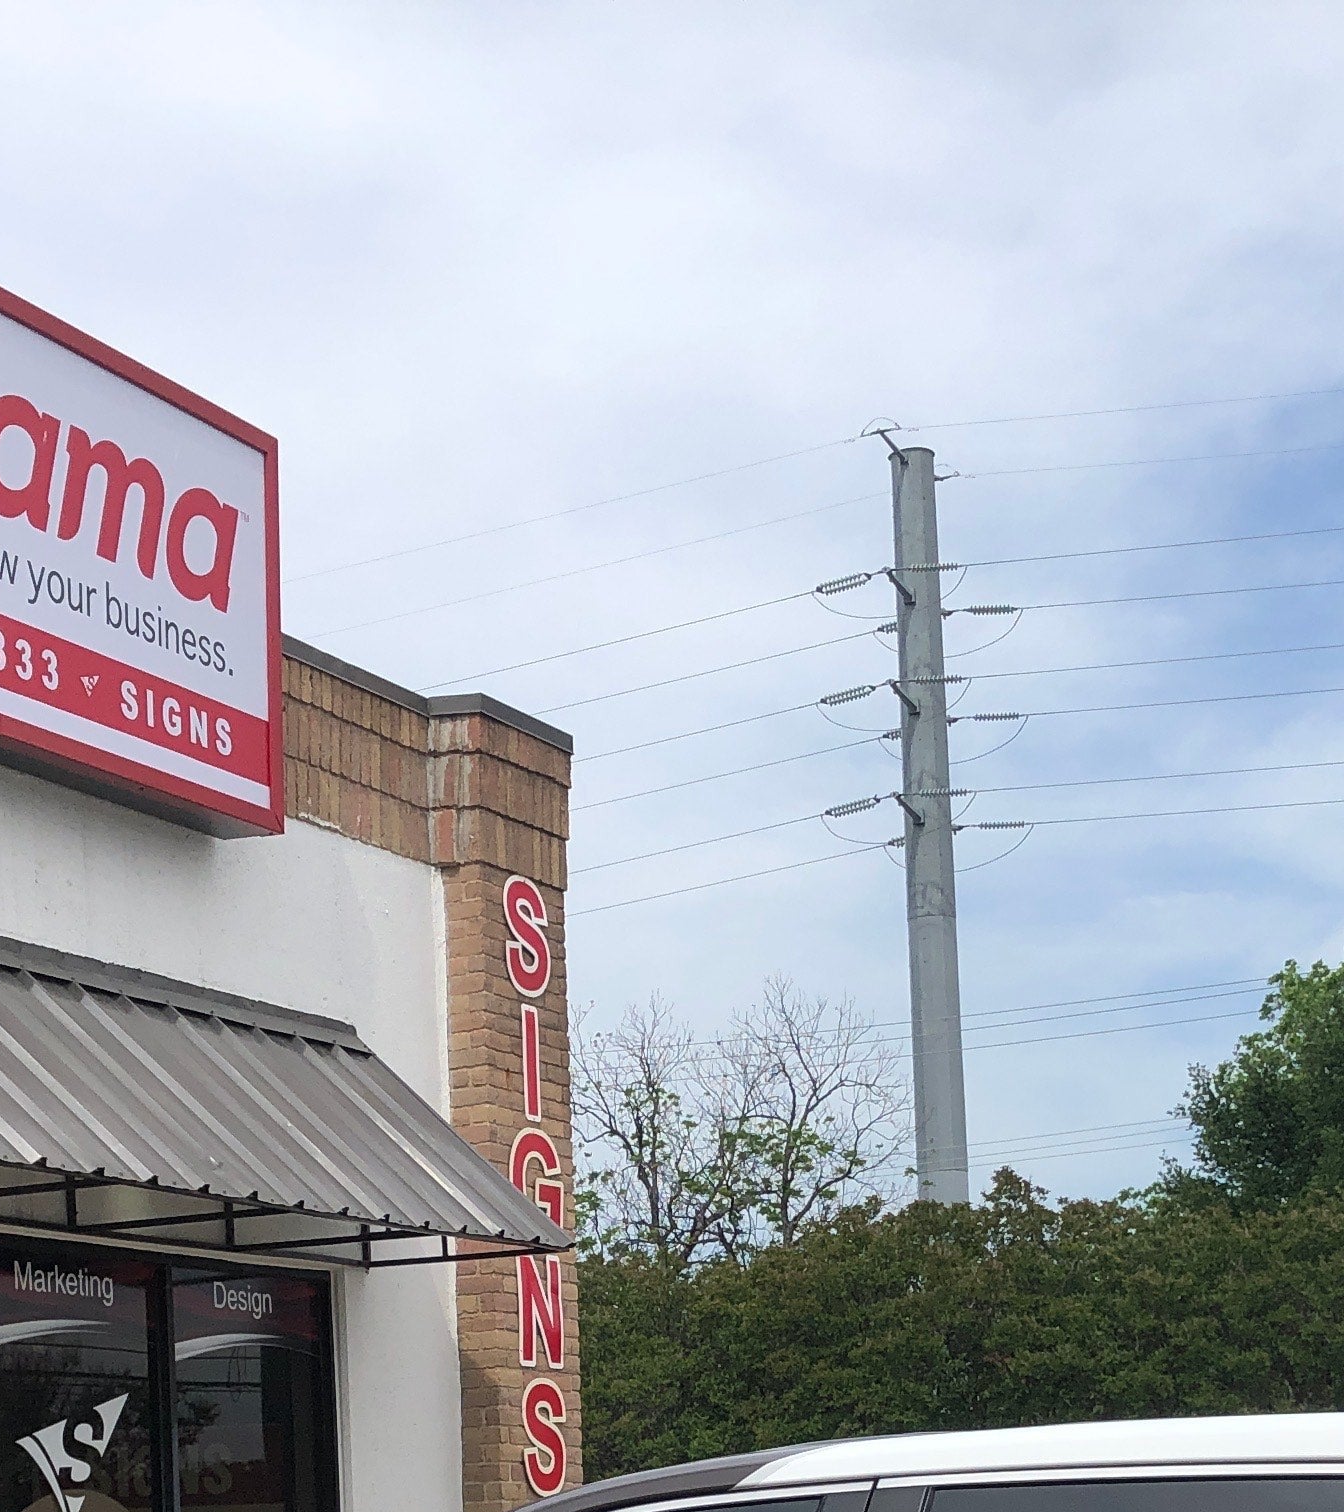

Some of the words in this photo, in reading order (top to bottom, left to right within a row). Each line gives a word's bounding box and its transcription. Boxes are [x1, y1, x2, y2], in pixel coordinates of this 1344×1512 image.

[26, 557, 97, 618] your
[104, 581, 235, 678] business.
[120, 678, 233, 757] SIGNS
[502, 874, 567, 1497] SIGNS
[13, 1260, 114, 1306] Marketing
[213, 1281, 273, 1320] Design
